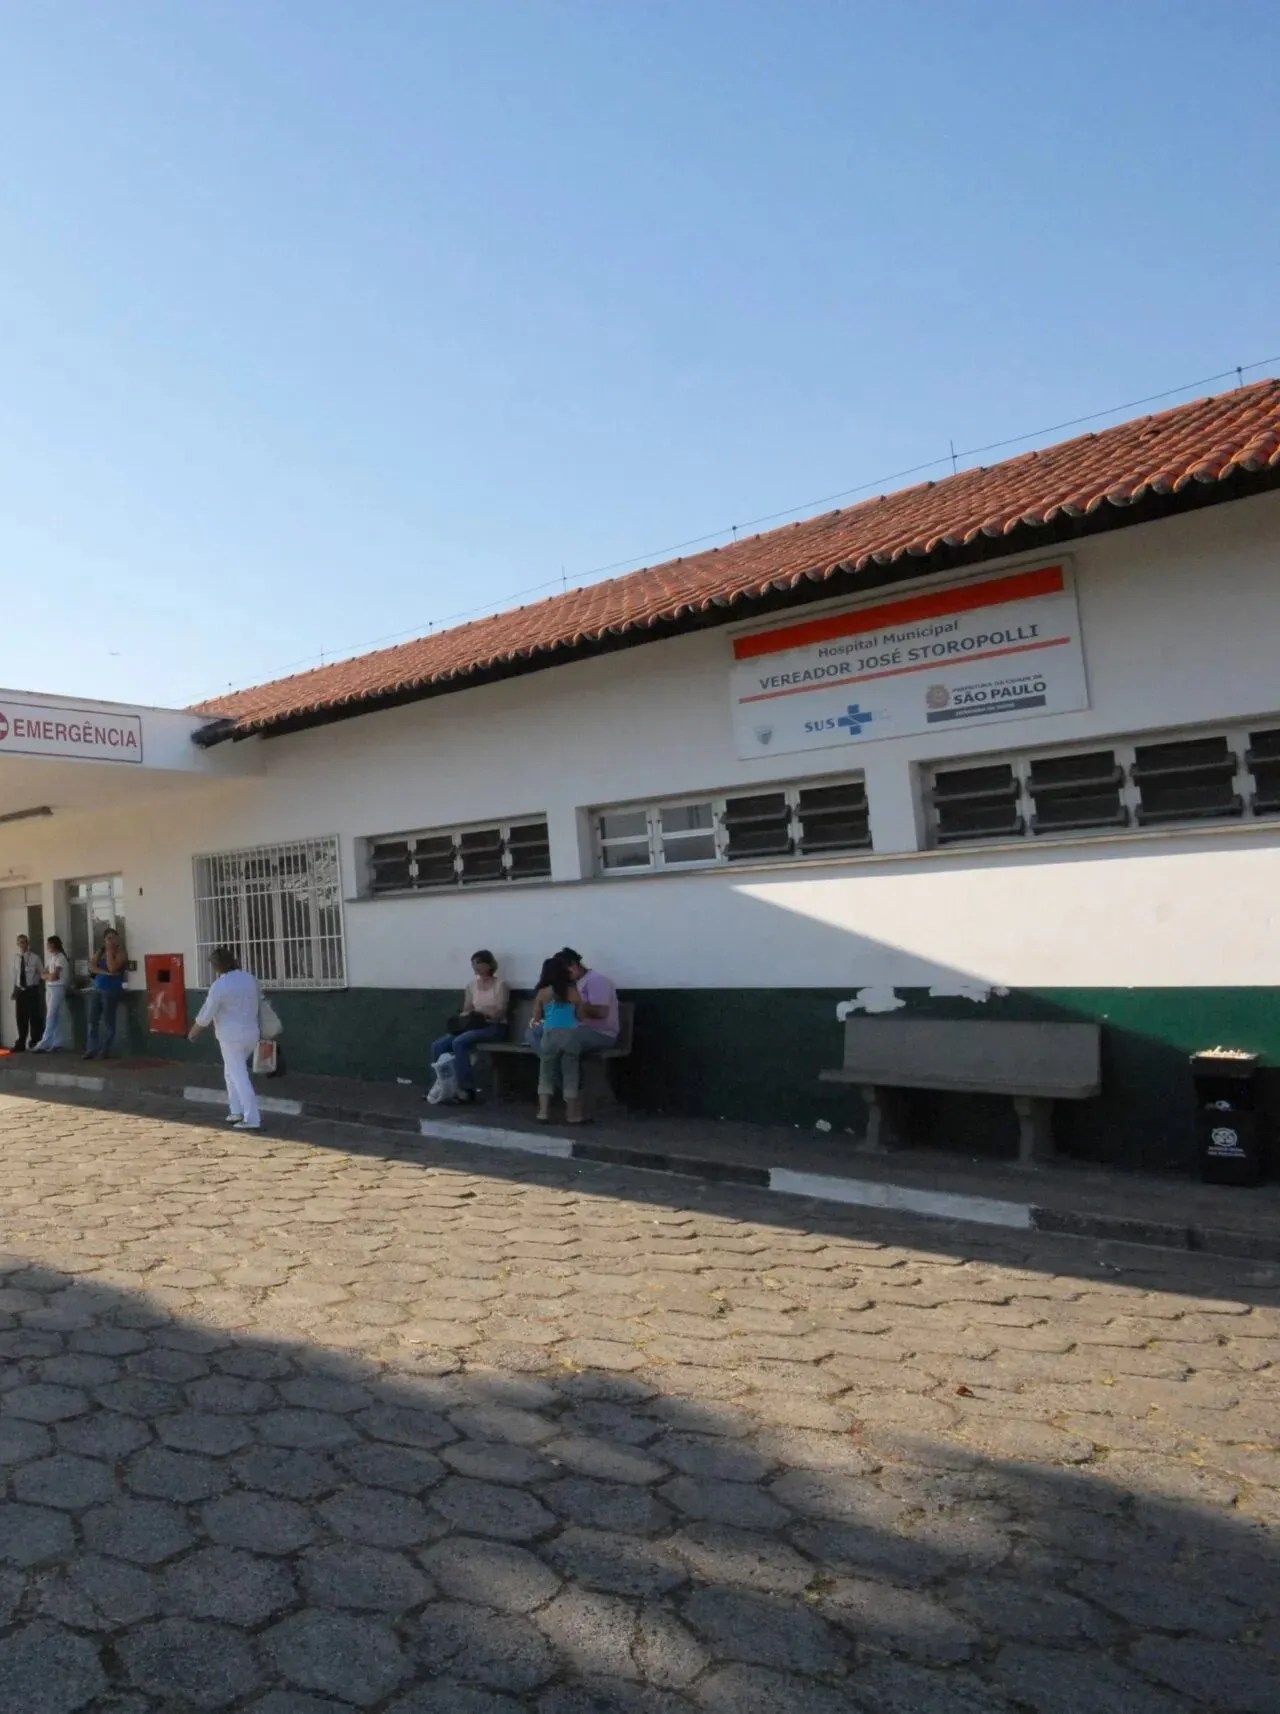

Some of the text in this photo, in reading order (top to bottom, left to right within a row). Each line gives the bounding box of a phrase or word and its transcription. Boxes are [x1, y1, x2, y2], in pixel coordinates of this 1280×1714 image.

[818, 620, 958, 658] Hospital Municipal
[759, 624, 1039, 690] VEREADOR JOSÉ STOROPOLLI
[954, 681, 1047, 705] SÃO PAULO
[13, 718, 138, 748] EMERGÊNCIA
[804, 718, 835, 732] SUS
